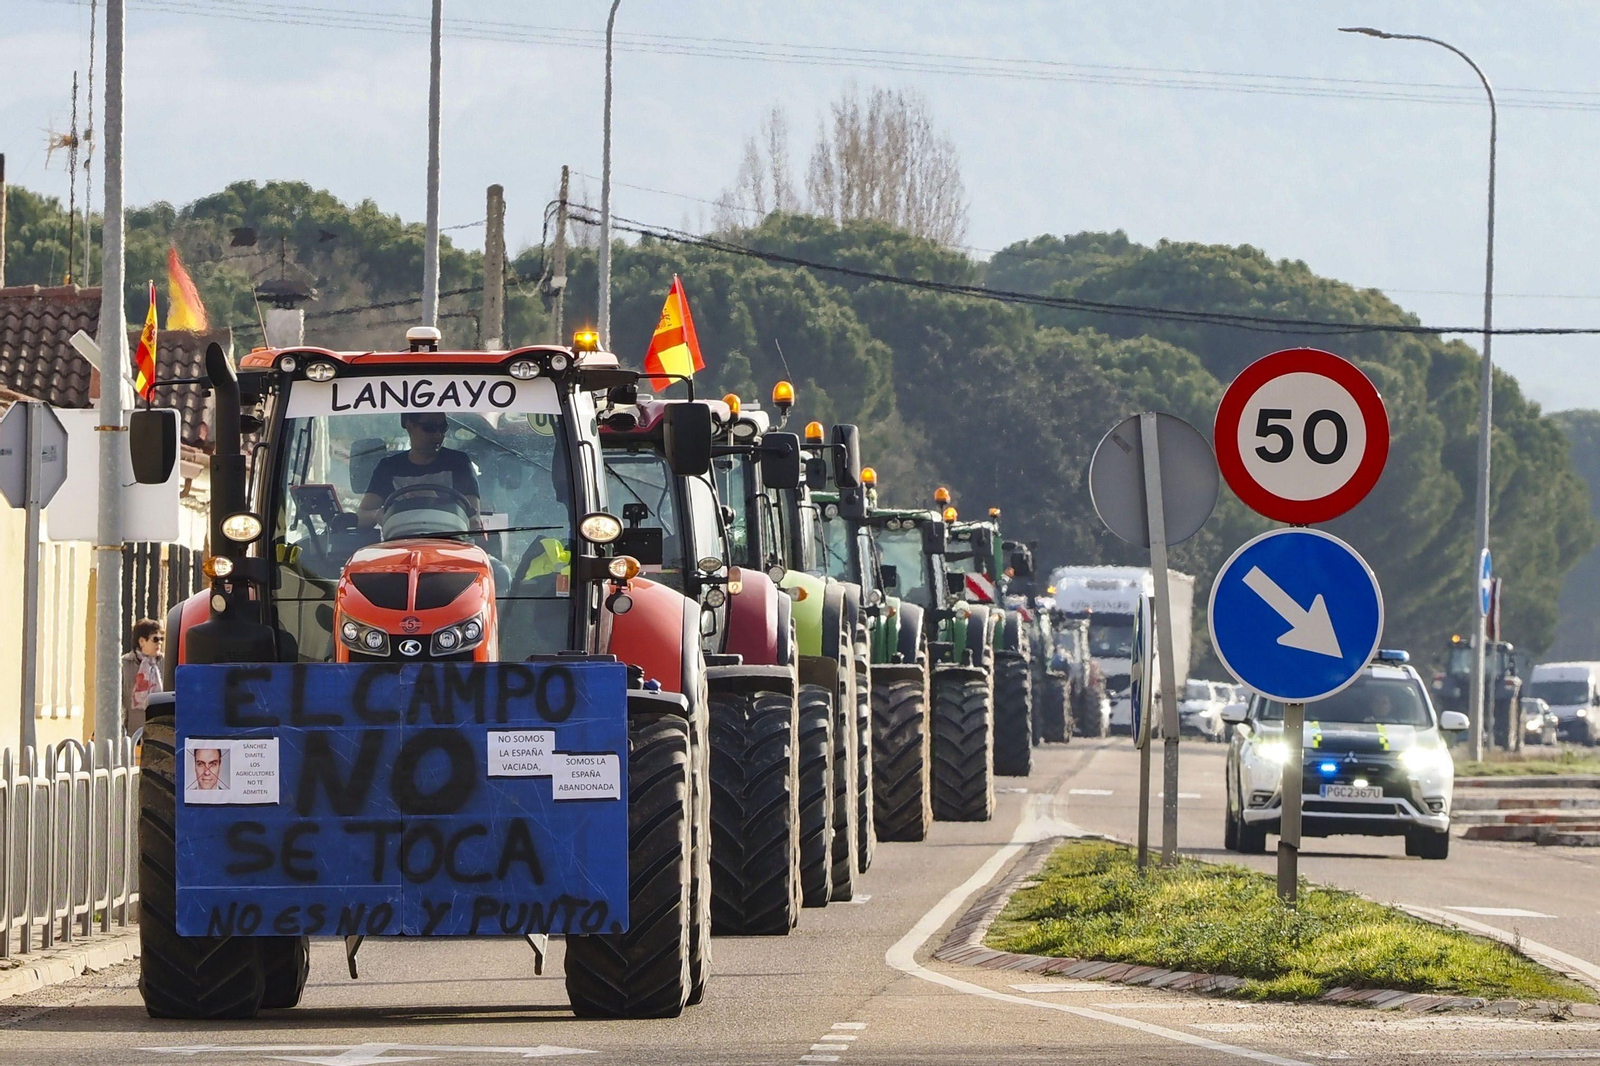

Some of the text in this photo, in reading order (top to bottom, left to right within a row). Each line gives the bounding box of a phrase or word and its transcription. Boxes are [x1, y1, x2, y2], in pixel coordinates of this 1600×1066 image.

[332, 379, 516, 411] LANGAYO
[1255, 408, 1348, 465] 50
[225, 662, 576, 727] EL CAMPO
[498, 735, 545, 743] NO SOMOS
[512, 747, 544, 757] ESPAÑA
[297, 729, 477, 815] NO
[502, 763, 541, 771] VACIADA,
[571, 770, 601, 778] ESPAÑA
[558, 783, 614, 791] ABANDONADA
[1327, 786, 1380, 798] PGC2367U
[226, 818, 545, 885] SE TOCA
[208, 894, 622, 936] NO ES NO Y PUNTO.
